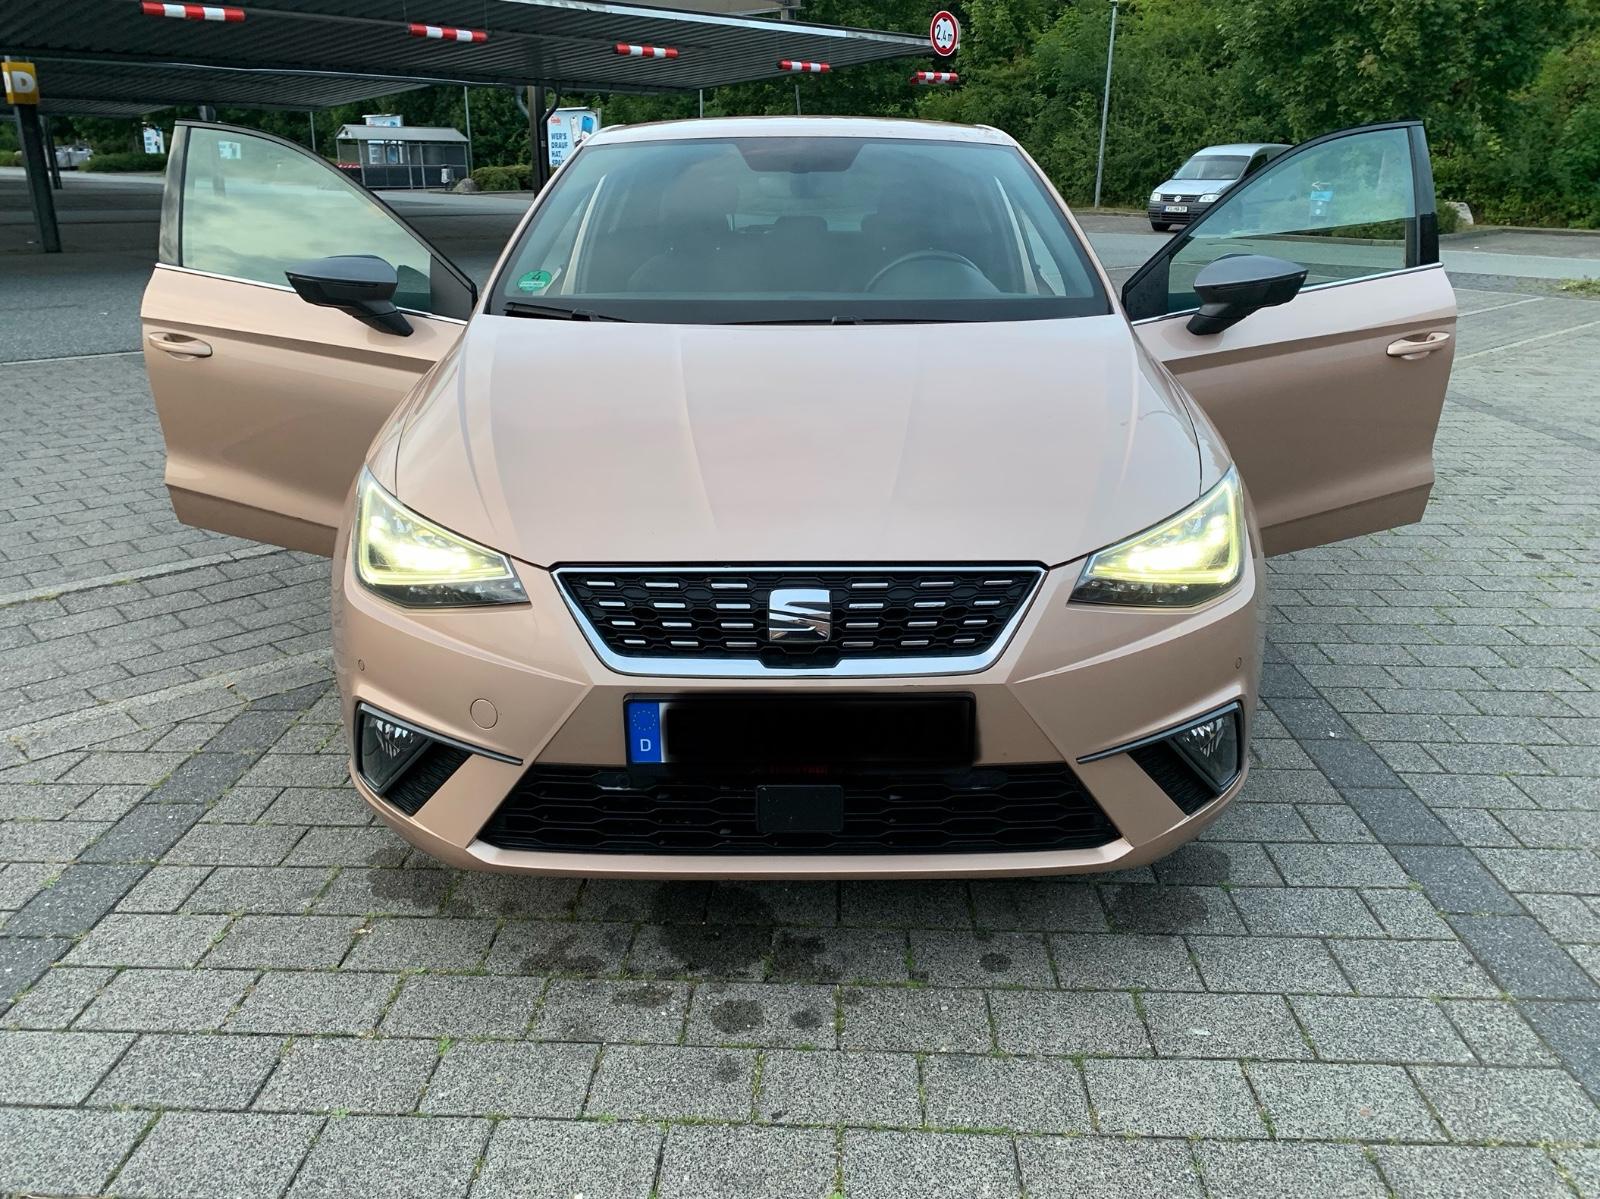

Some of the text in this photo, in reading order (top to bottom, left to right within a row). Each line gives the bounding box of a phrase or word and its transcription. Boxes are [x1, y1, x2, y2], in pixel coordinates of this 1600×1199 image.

[11, 70, 35, 94] D
[551, 141, 568, 149] DRAUF
[640, 738, 652, 752] D
